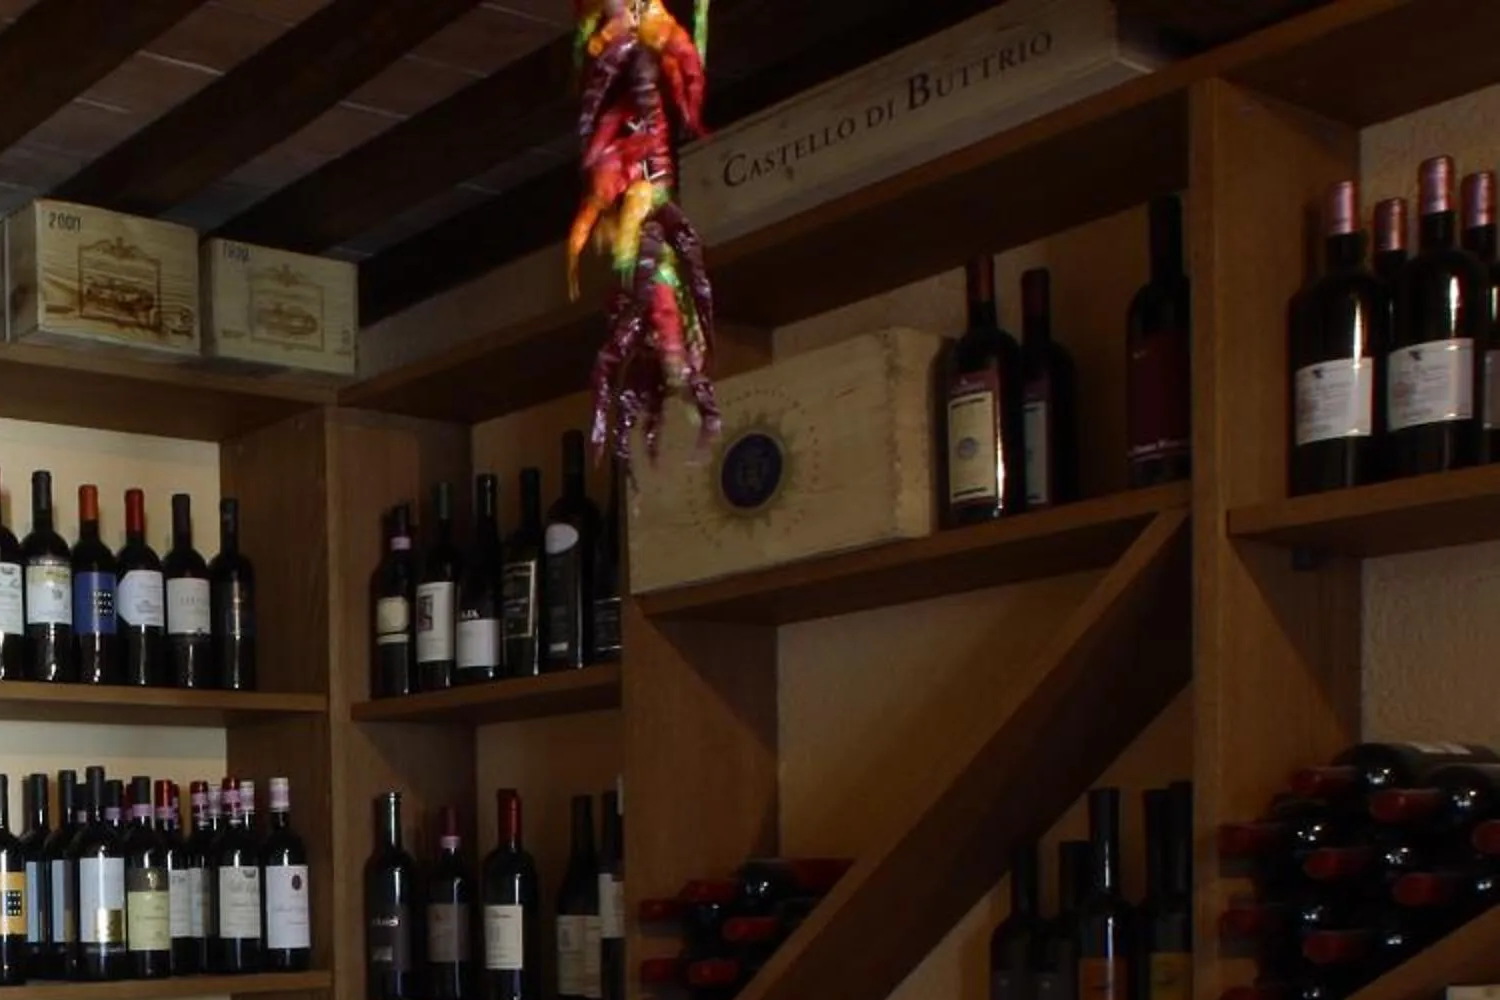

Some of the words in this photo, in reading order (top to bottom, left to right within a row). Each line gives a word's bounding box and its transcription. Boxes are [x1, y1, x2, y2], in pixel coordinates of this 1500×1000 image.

[721, 116, 856, 188] CASTELLO
[865, 101, 896, 128] DI
[906, 32, 1053, 111] BUTTRIO
